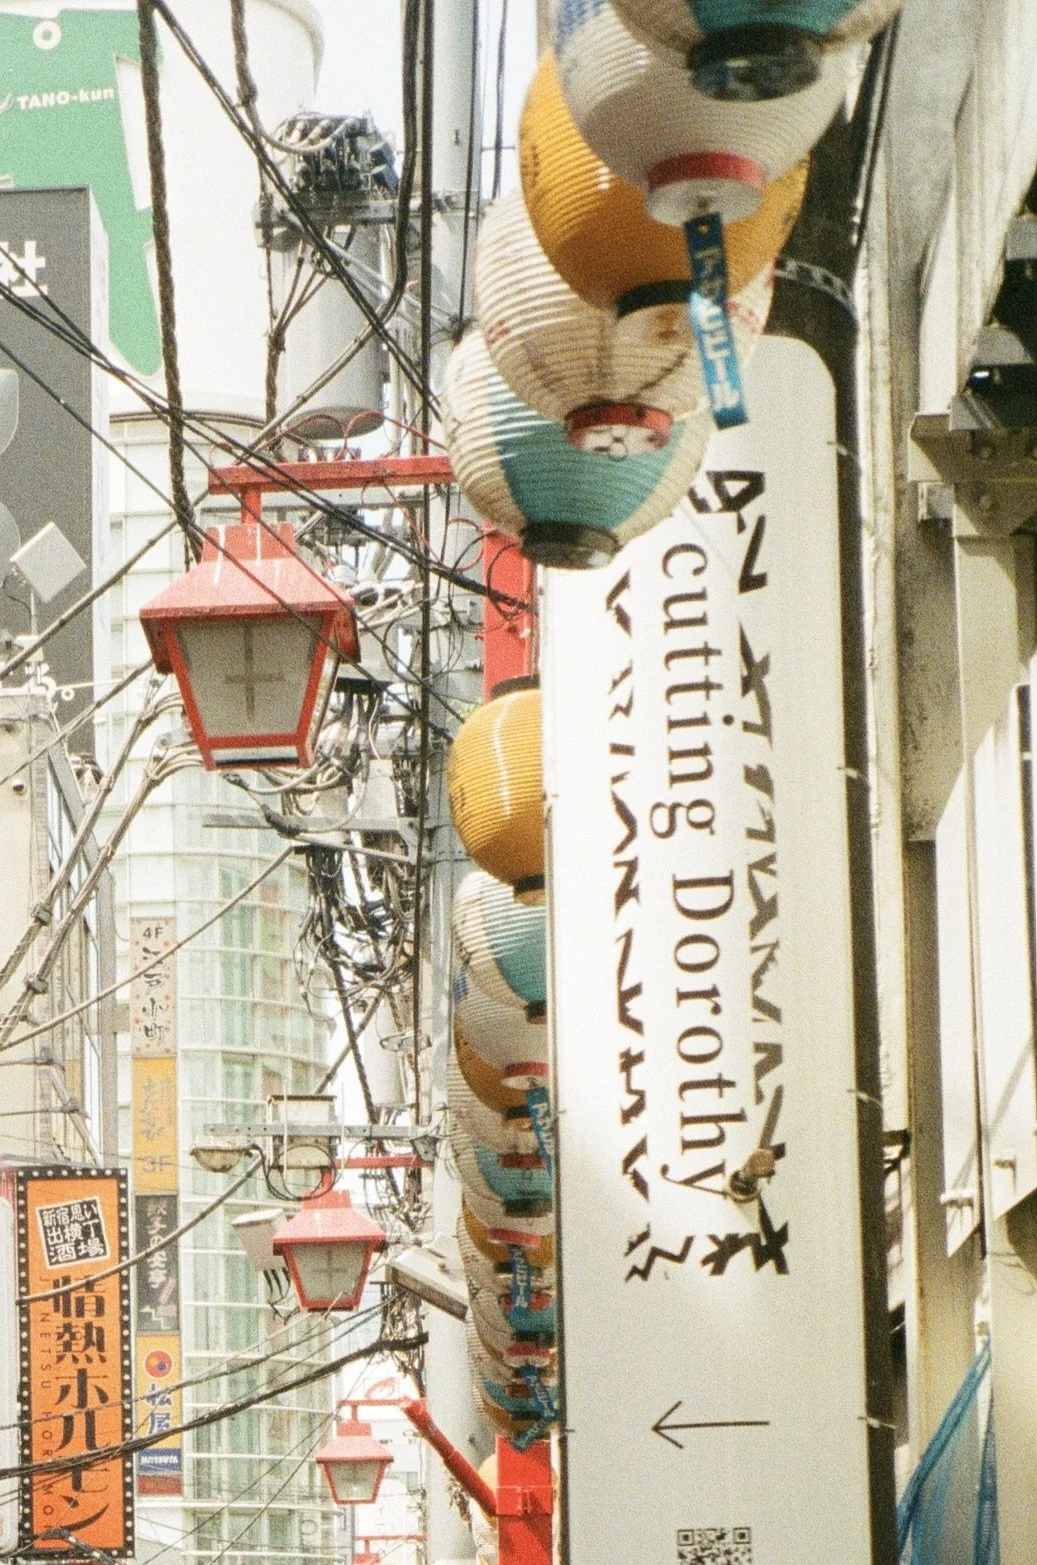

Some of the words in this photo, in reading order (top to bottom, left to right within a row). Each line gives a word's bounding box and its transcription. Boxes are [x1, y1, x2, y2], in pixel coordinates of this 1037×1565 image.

[17, 88, 115, 110] TANO-kun
[649, 541, 734, 840] cutting
[141, 926, 163, 940] 4F
[661, 874, 749, 1199] Dorothy
[39, 1276, 52, 1389] JNETSU
